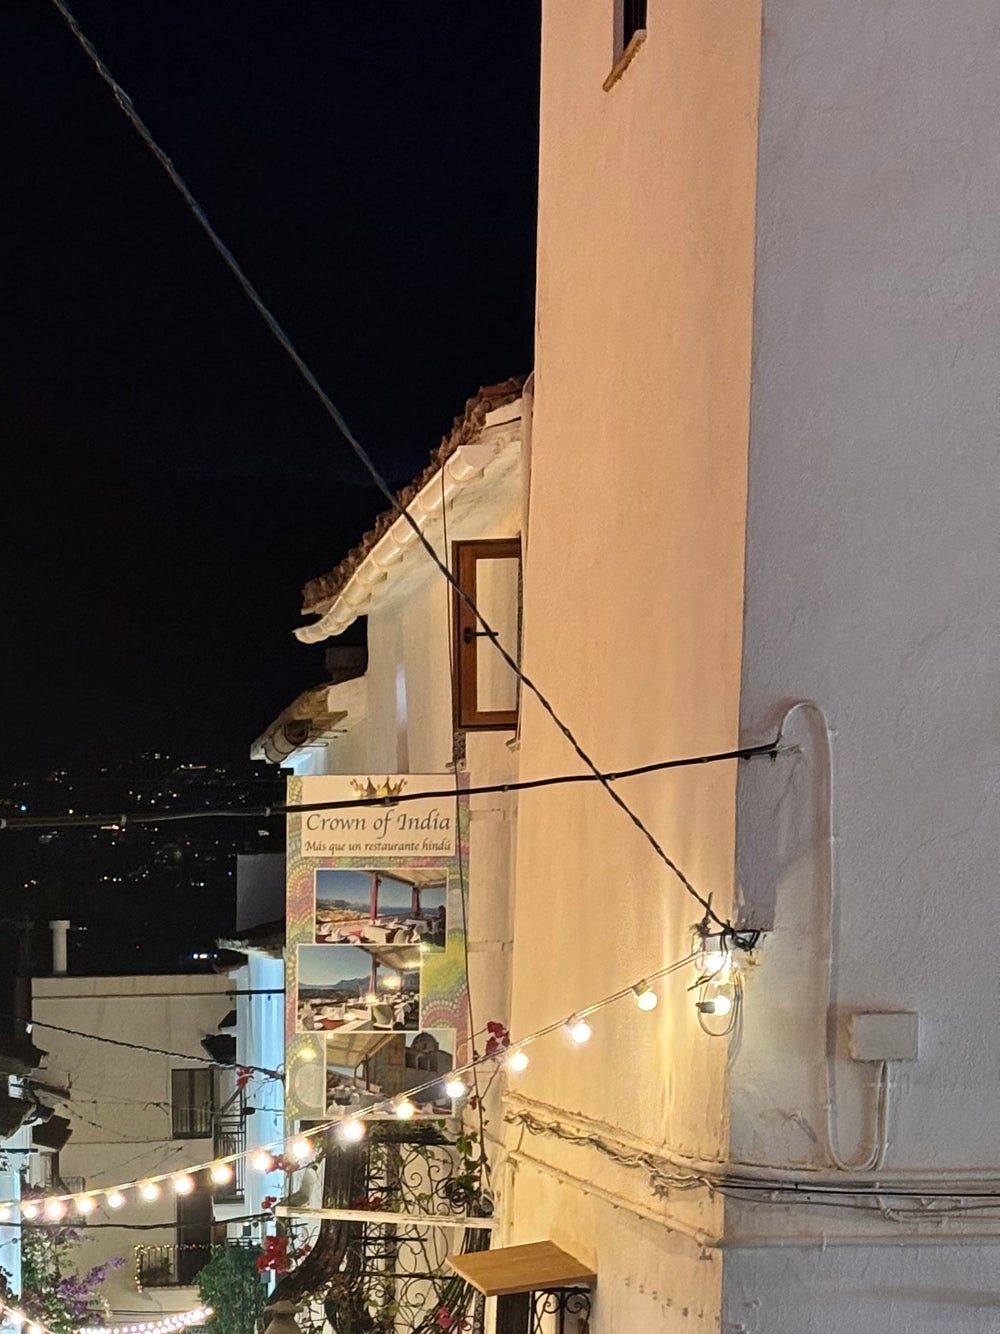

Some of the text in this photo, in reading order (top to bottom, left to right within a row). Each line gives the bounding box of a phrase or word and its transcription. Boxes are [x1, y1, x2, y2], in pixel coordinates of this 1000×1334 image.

[306, 808, 450, 840] Crown of India
[304, 837, 450, 855] Más que un restaurante hindú
